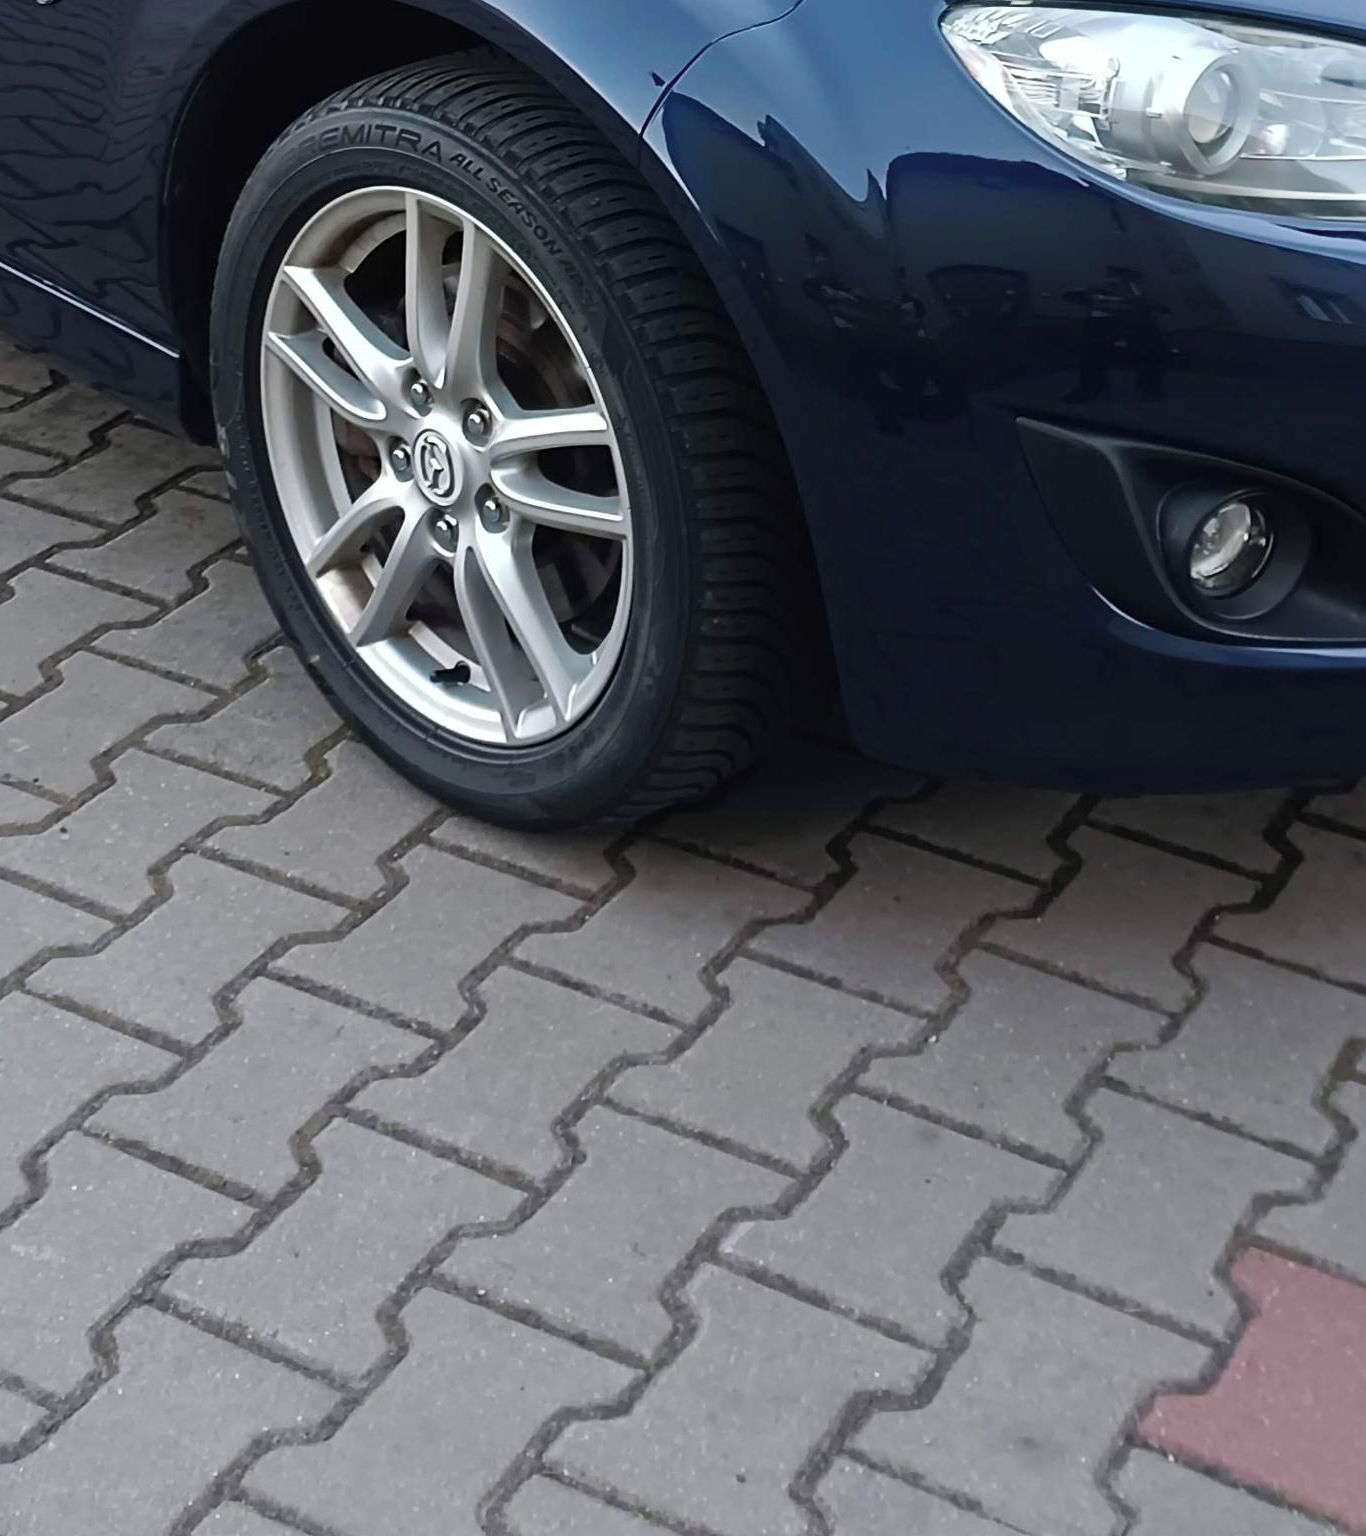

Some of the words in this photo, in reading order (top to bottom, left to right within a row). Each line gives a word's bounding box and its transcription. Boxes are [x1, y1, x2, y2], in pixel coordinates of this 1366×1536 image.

[281, 123, 444, 164] PREMITRA
[449, 153, 486, 182] ALL
[485, 178, 565, 258] SEASON
